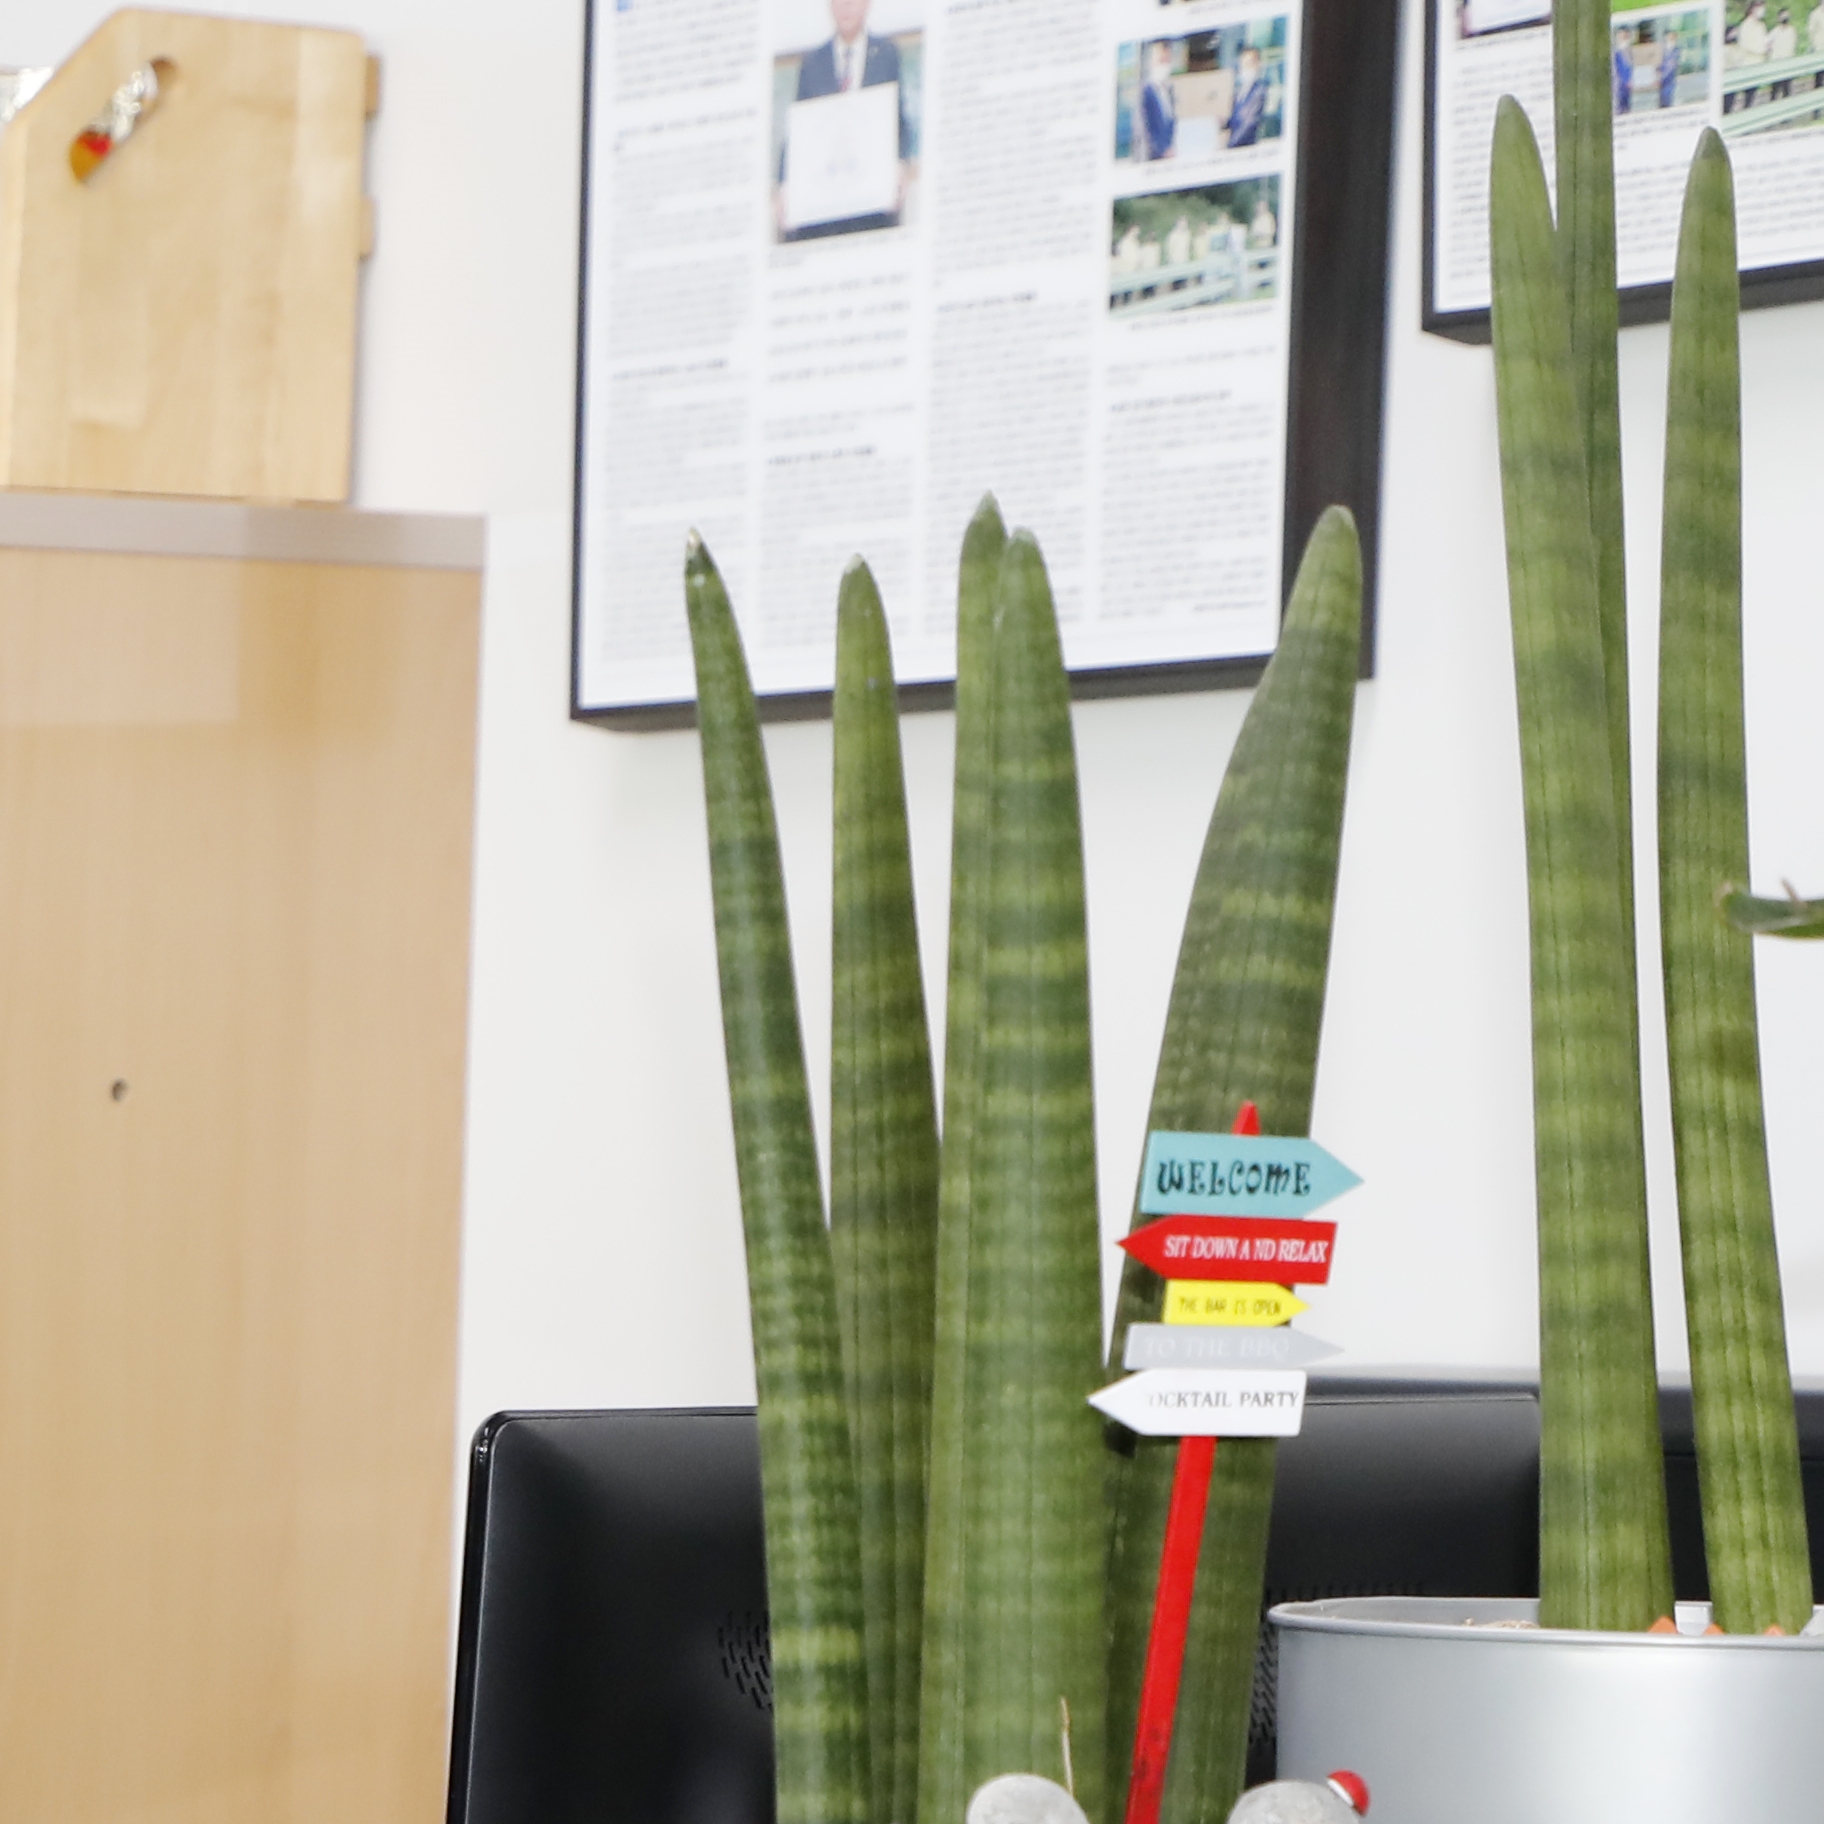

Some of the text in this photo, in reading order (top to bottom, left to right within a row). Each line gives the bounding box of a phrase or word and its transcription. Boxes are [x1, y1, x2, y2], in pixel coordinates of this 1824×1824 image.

[1157, 1158, 1313, 1197] WELCOME
[1164, 1236, 1189, 1259] SIT
[1191, 1236, 1238, 1260] DOWN
[1278, 1239, 1329, 1264] RELAX
[1178, 1297, 1282, 1316] THE BAR IS OPEN
[1145, 1337, 1291, 1363] TO THE BBQ
[1239, 1391, 1301, 1408] PARTY
